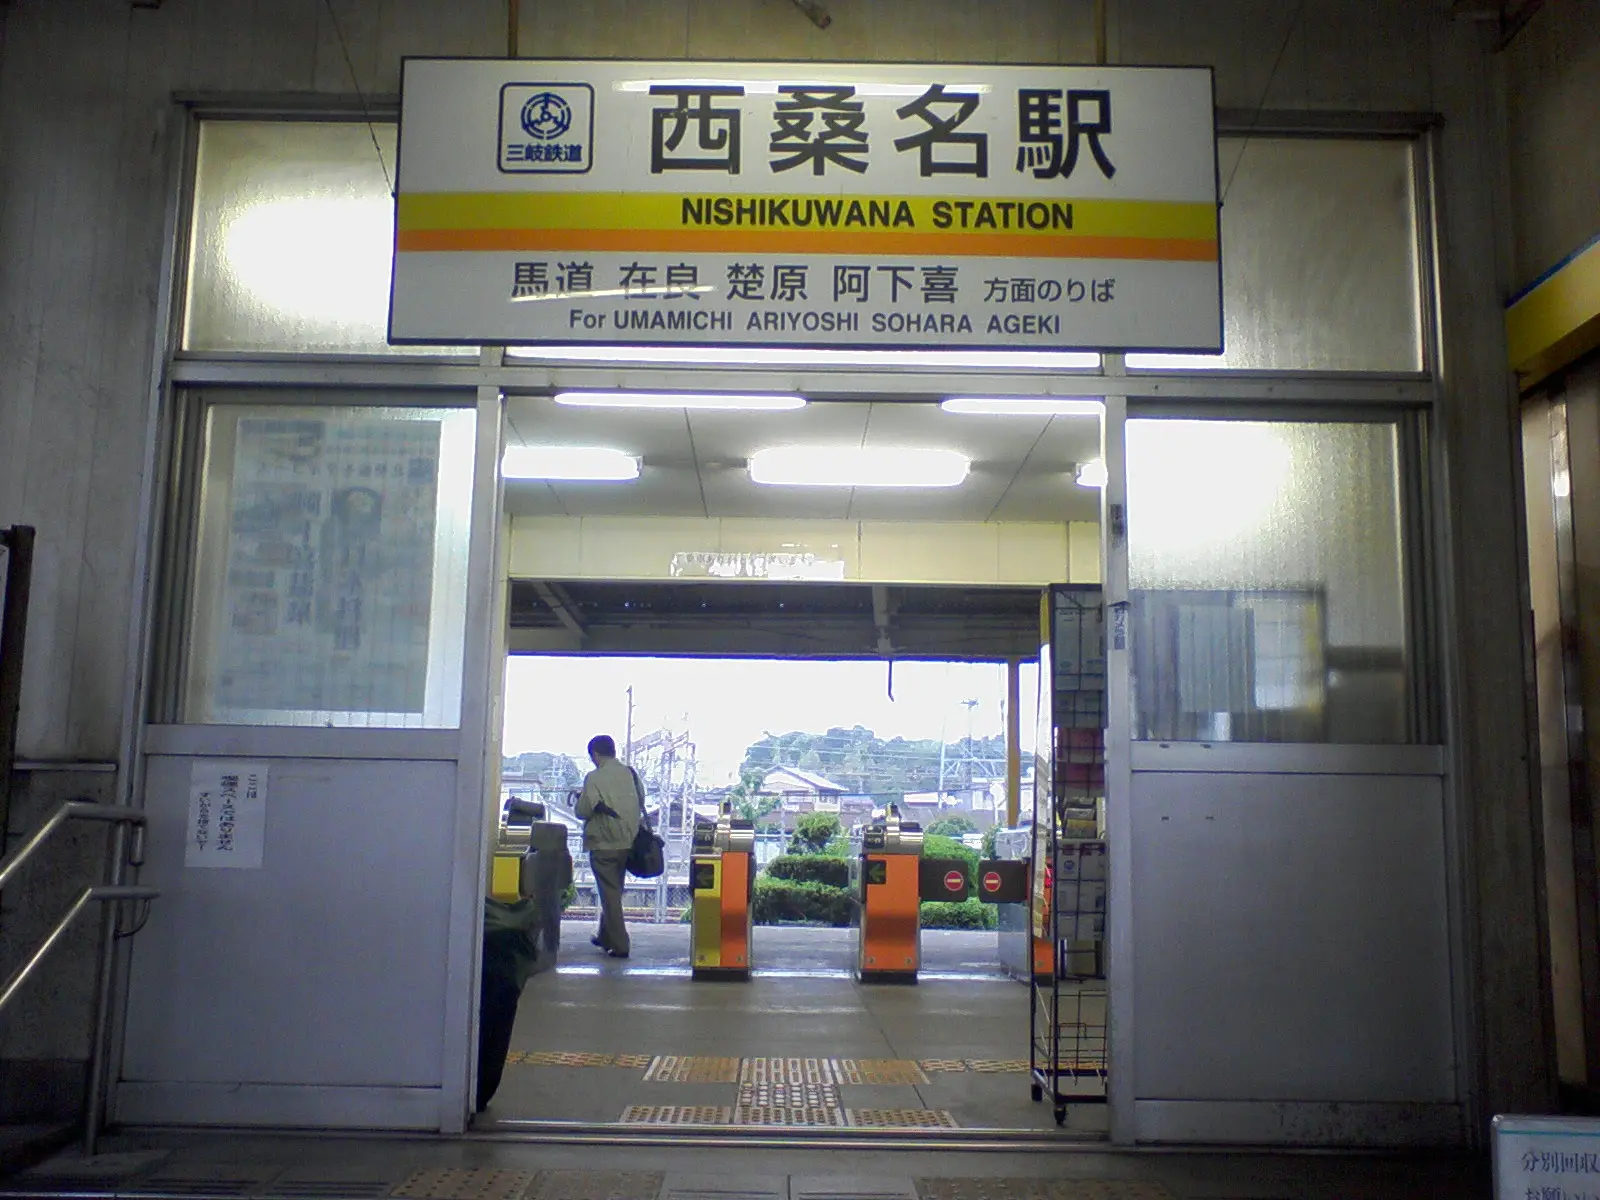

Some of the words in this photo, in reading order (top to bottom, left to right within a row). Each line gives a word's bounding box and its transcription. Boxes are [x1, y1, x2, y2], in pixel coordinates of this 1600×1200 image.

[649, 84, 1116, 180] 西桑名駅
[506, 143, 583, 163] 三岐鉄道
[682, 198, 914, 228] NISHIKUWANA
[933, 203, 1074, 230] STATION
[511, 261, 594, 300] 馬道
[619, 262, 703, 301] 在良
[726, 263, 810, 301] 楚原
[833, 265, 959, 304] 阿下喜
[984, 278, 1116, 303] 方面のりば
[570, 309, 606, 329] For
[614, 310, 733, 331] UMAMICHI
[746, 312, 859, 333] ARIYOSHI
[872, 313, 973, 334] SOHARA
[987, 315, 1061, 335] AGEKI
